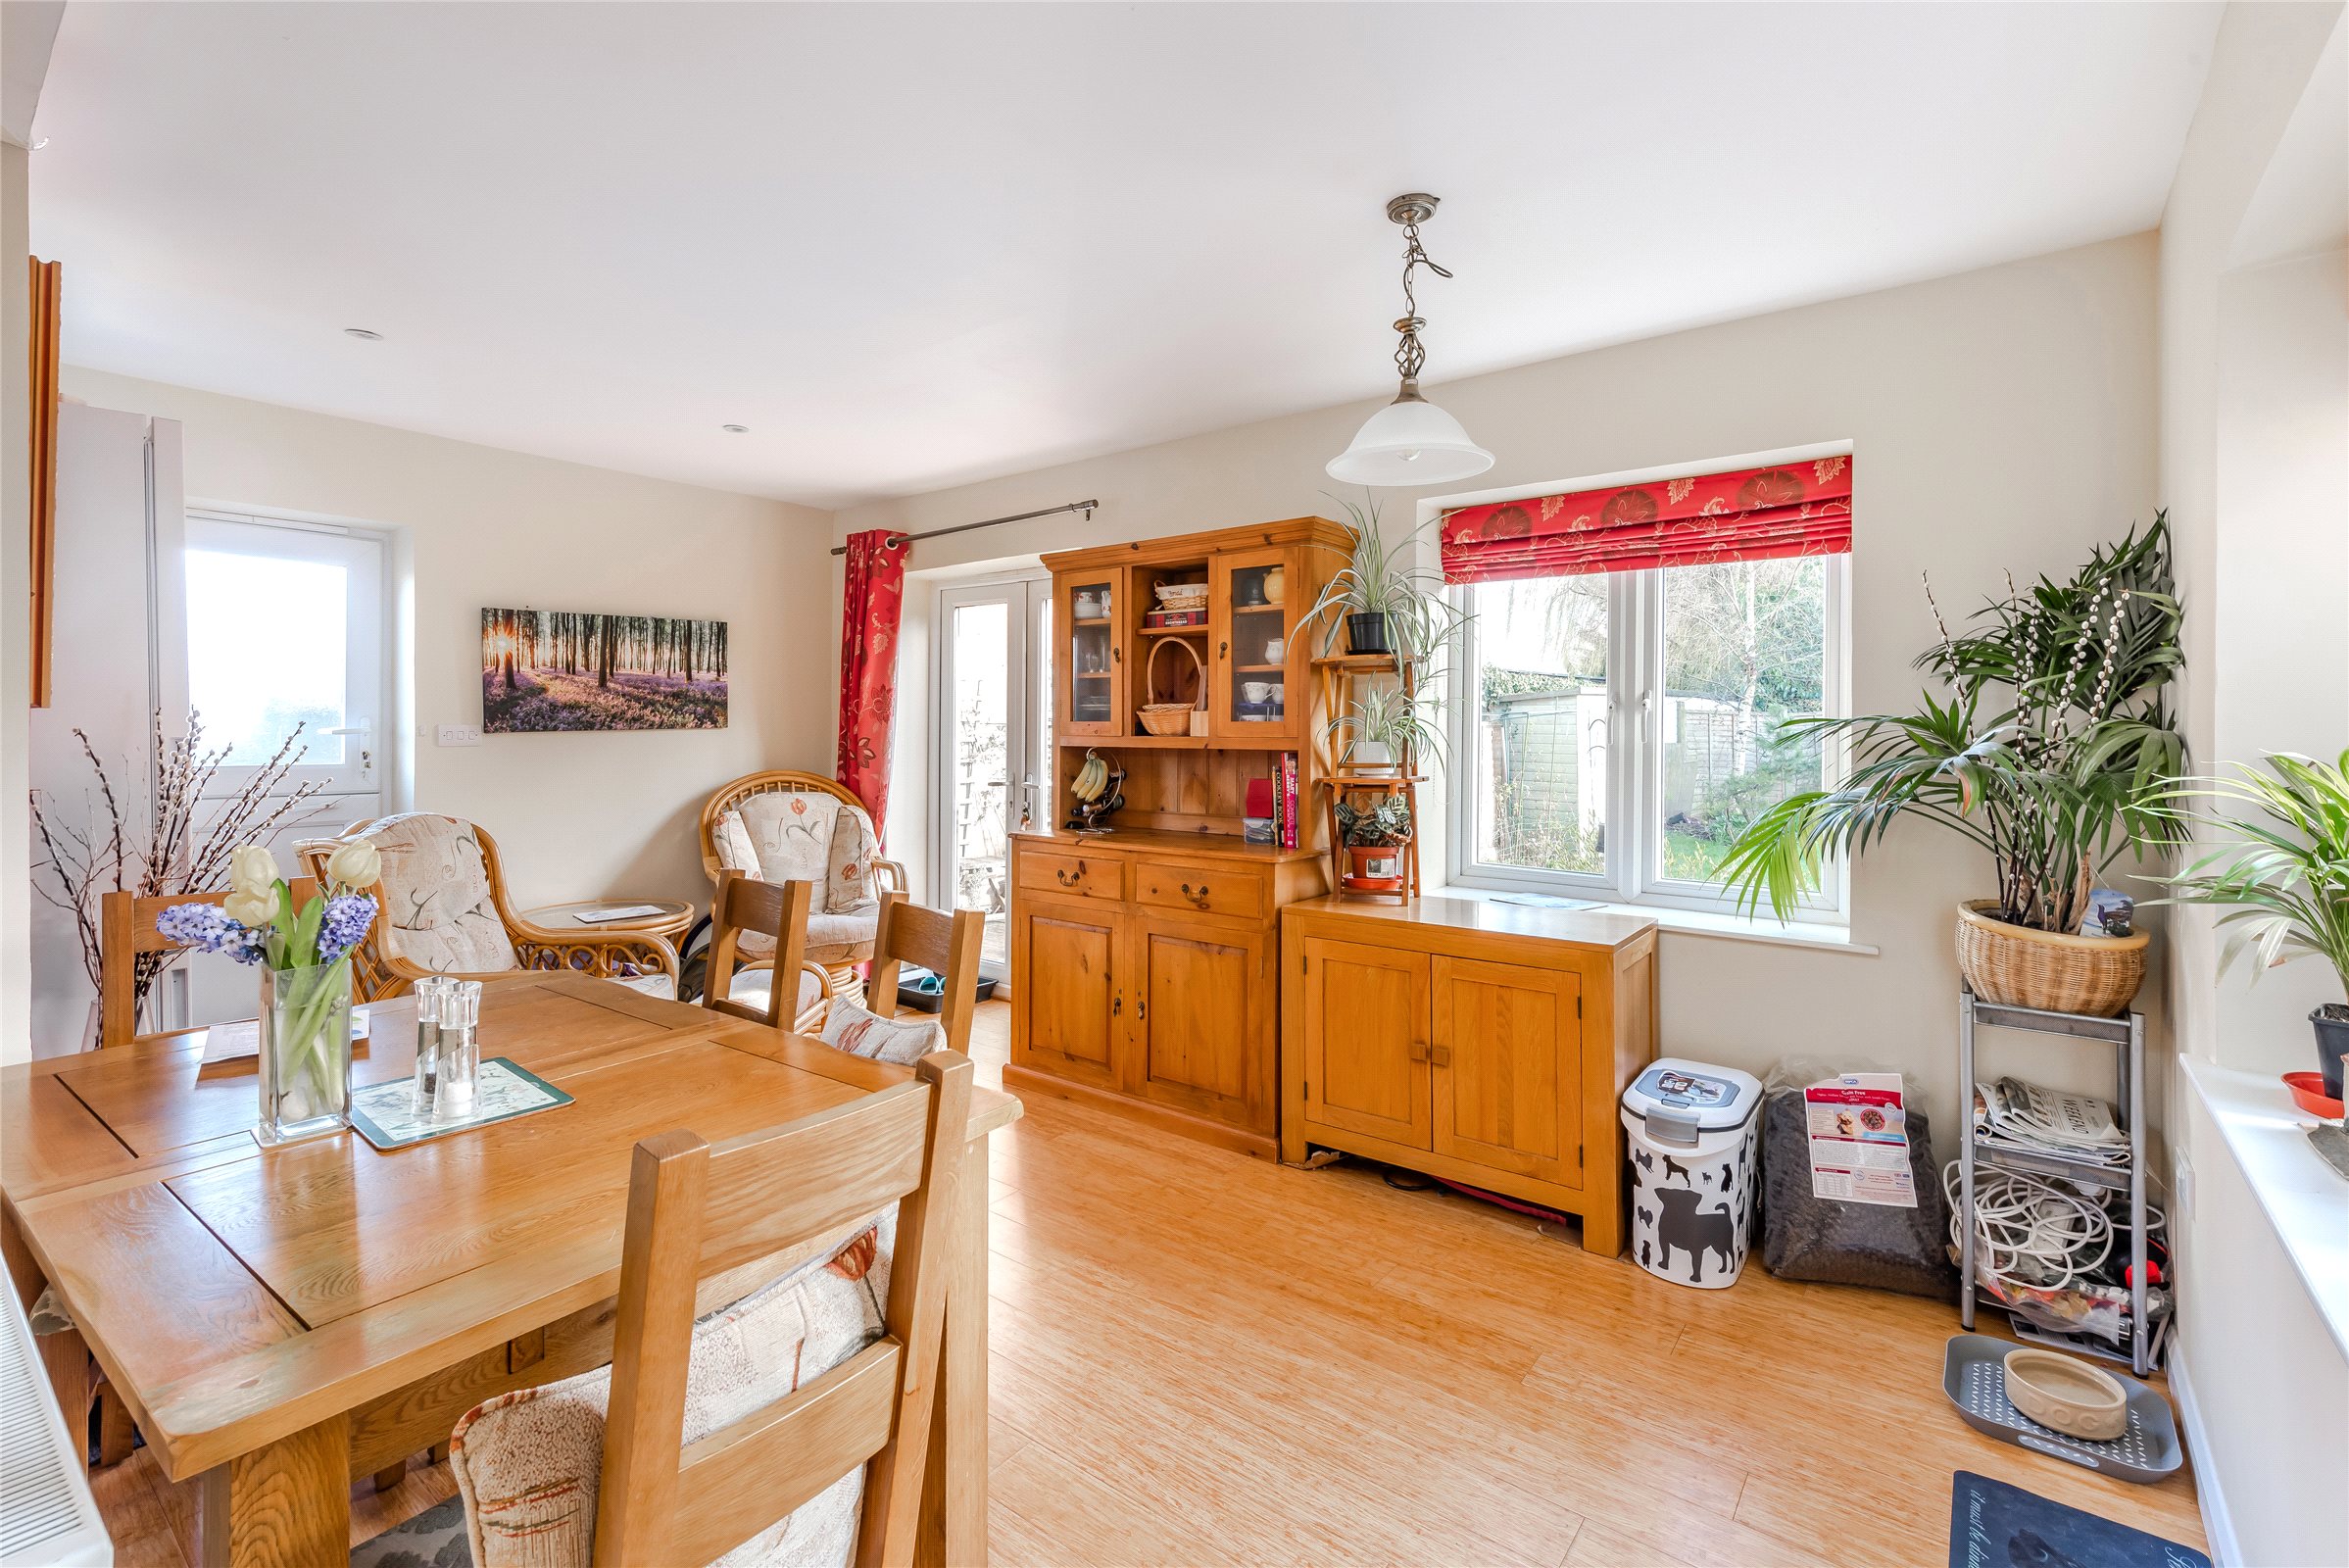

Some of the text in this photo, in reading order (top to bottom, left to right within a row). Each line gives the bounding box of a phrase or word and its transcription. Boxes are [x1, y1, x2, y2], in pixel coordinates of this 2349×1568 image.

[2062, 1099, 2089, 1134] WEEKEND
[2029, 1395, 2100, 1432] DOG
[1968, 1489, 1991, 1568] it must be dinn
